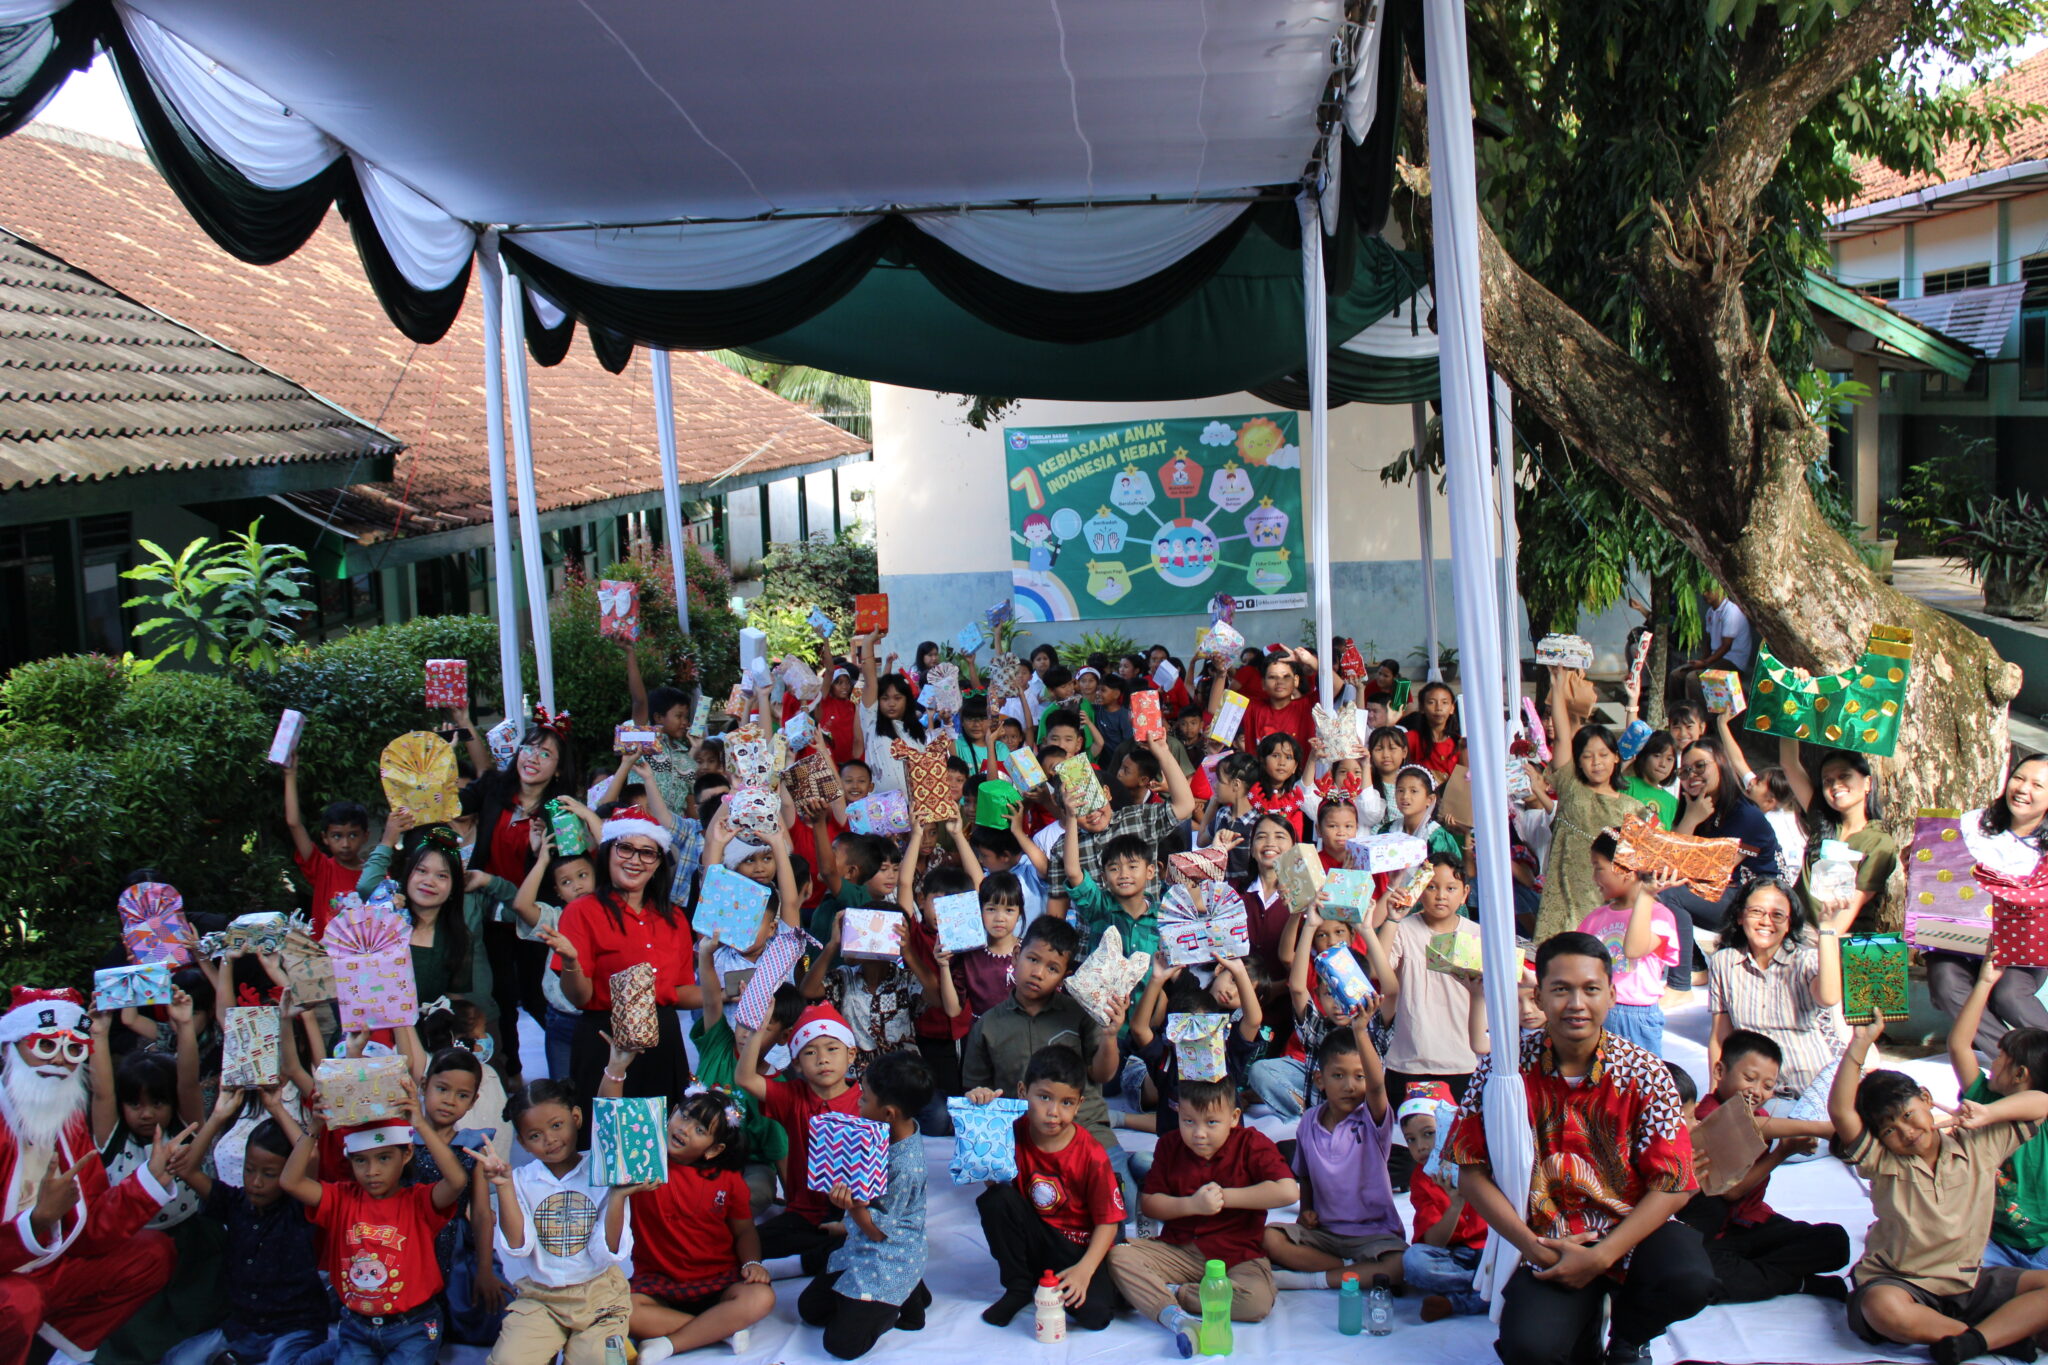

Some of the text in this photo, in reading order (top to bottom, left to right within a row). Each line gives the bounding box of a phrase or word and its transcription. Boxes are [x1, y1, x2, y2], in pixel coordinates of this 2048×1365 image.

[1037, 422, 1166, 477] KEBIASAAN ANAK
[1046, 440, 1168, 495] INDONESIA HEBAT
[1010, 466, 1046, 511] 7
